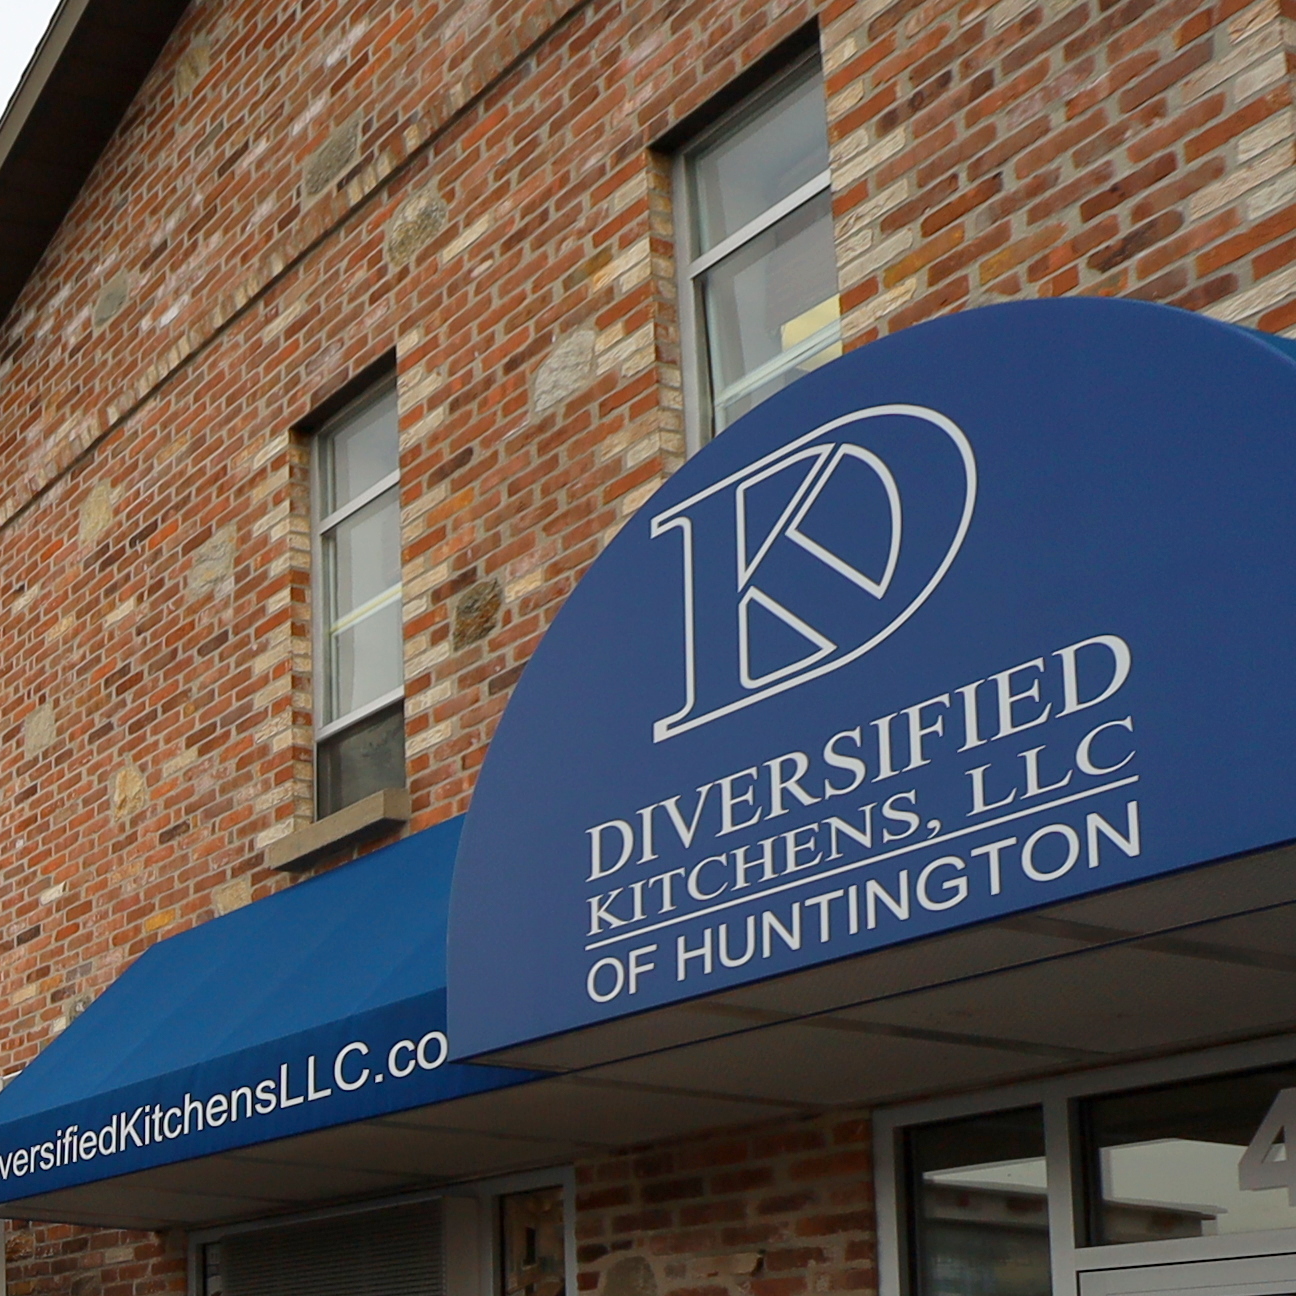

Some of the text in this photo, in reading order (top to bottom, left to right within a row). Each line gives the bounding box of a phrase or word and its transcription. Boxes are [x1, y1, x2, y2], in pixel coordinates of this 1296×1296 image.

[585, 633, 1132, 883] DIVERSIFIED
[586, 715, 1138, 936] KITCHENS, LLC
[586, 800, 1142, 1003] OF HUNTINGTON
